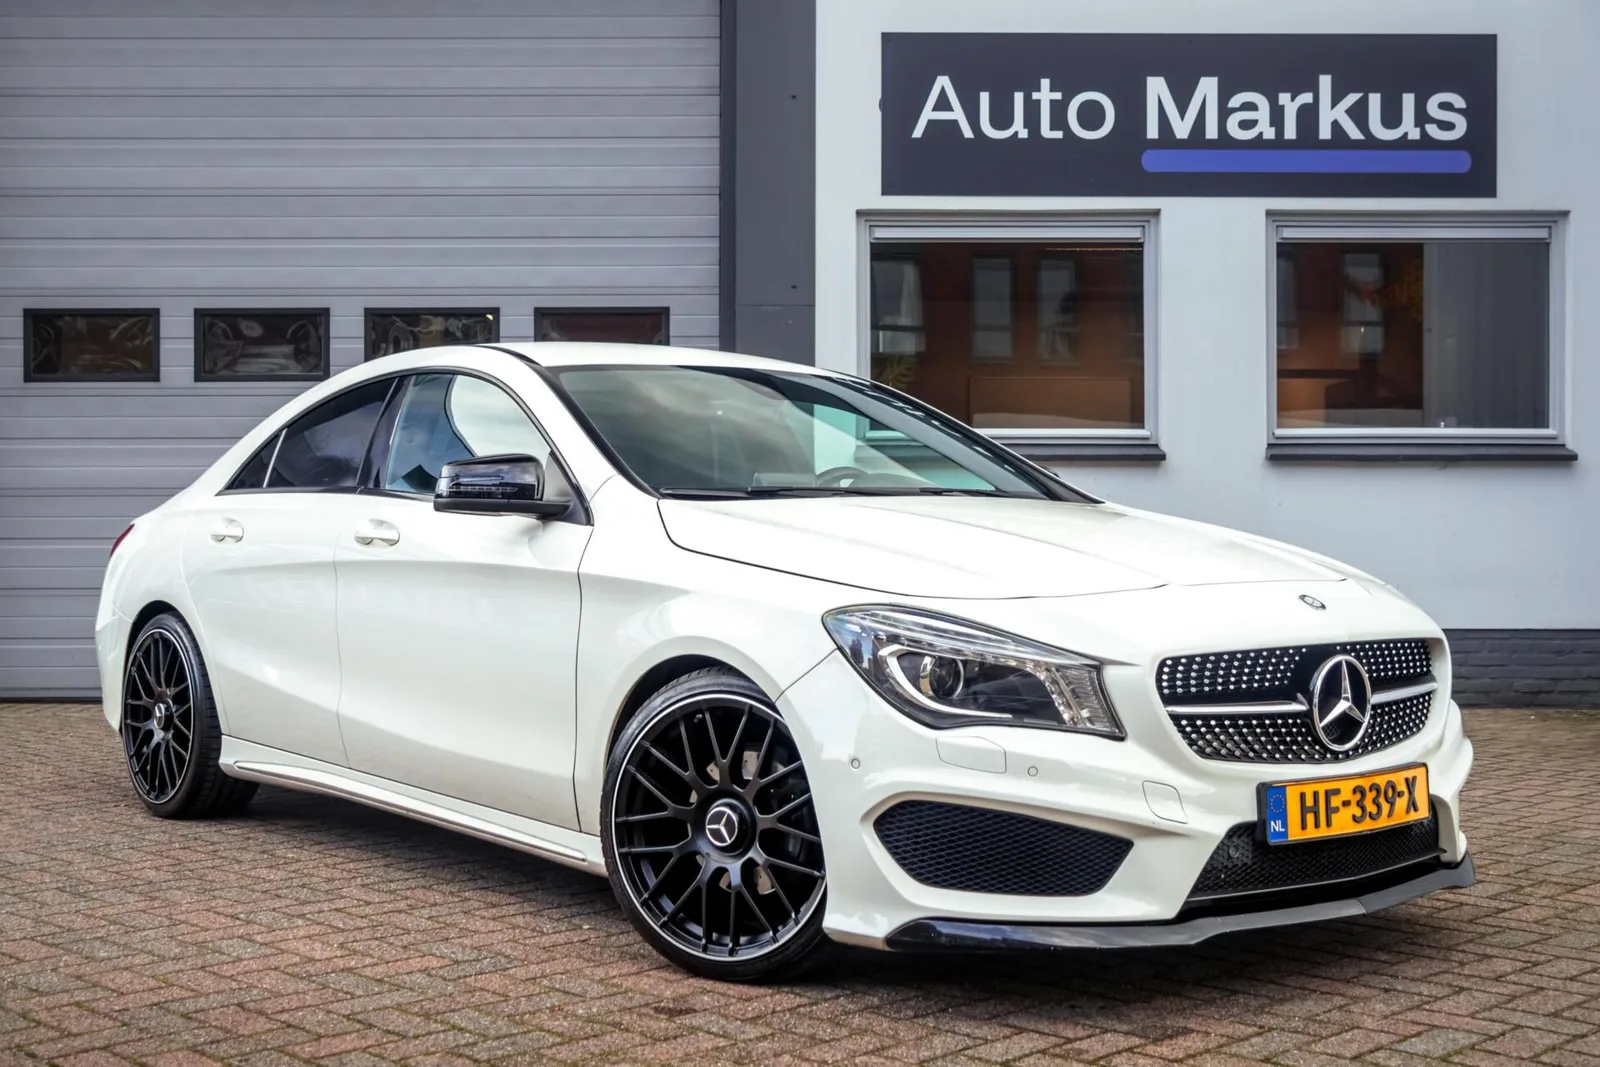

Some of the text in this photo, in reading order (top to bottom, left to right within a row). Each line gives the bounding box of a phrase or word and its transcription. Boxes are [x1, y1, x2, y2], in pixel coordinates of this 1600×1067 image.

[911, 74, 1468, 141] Auto Markus
[1270, 819, 1286, 833] NL
[1299, 775, 1419, 831] HF-339-X
